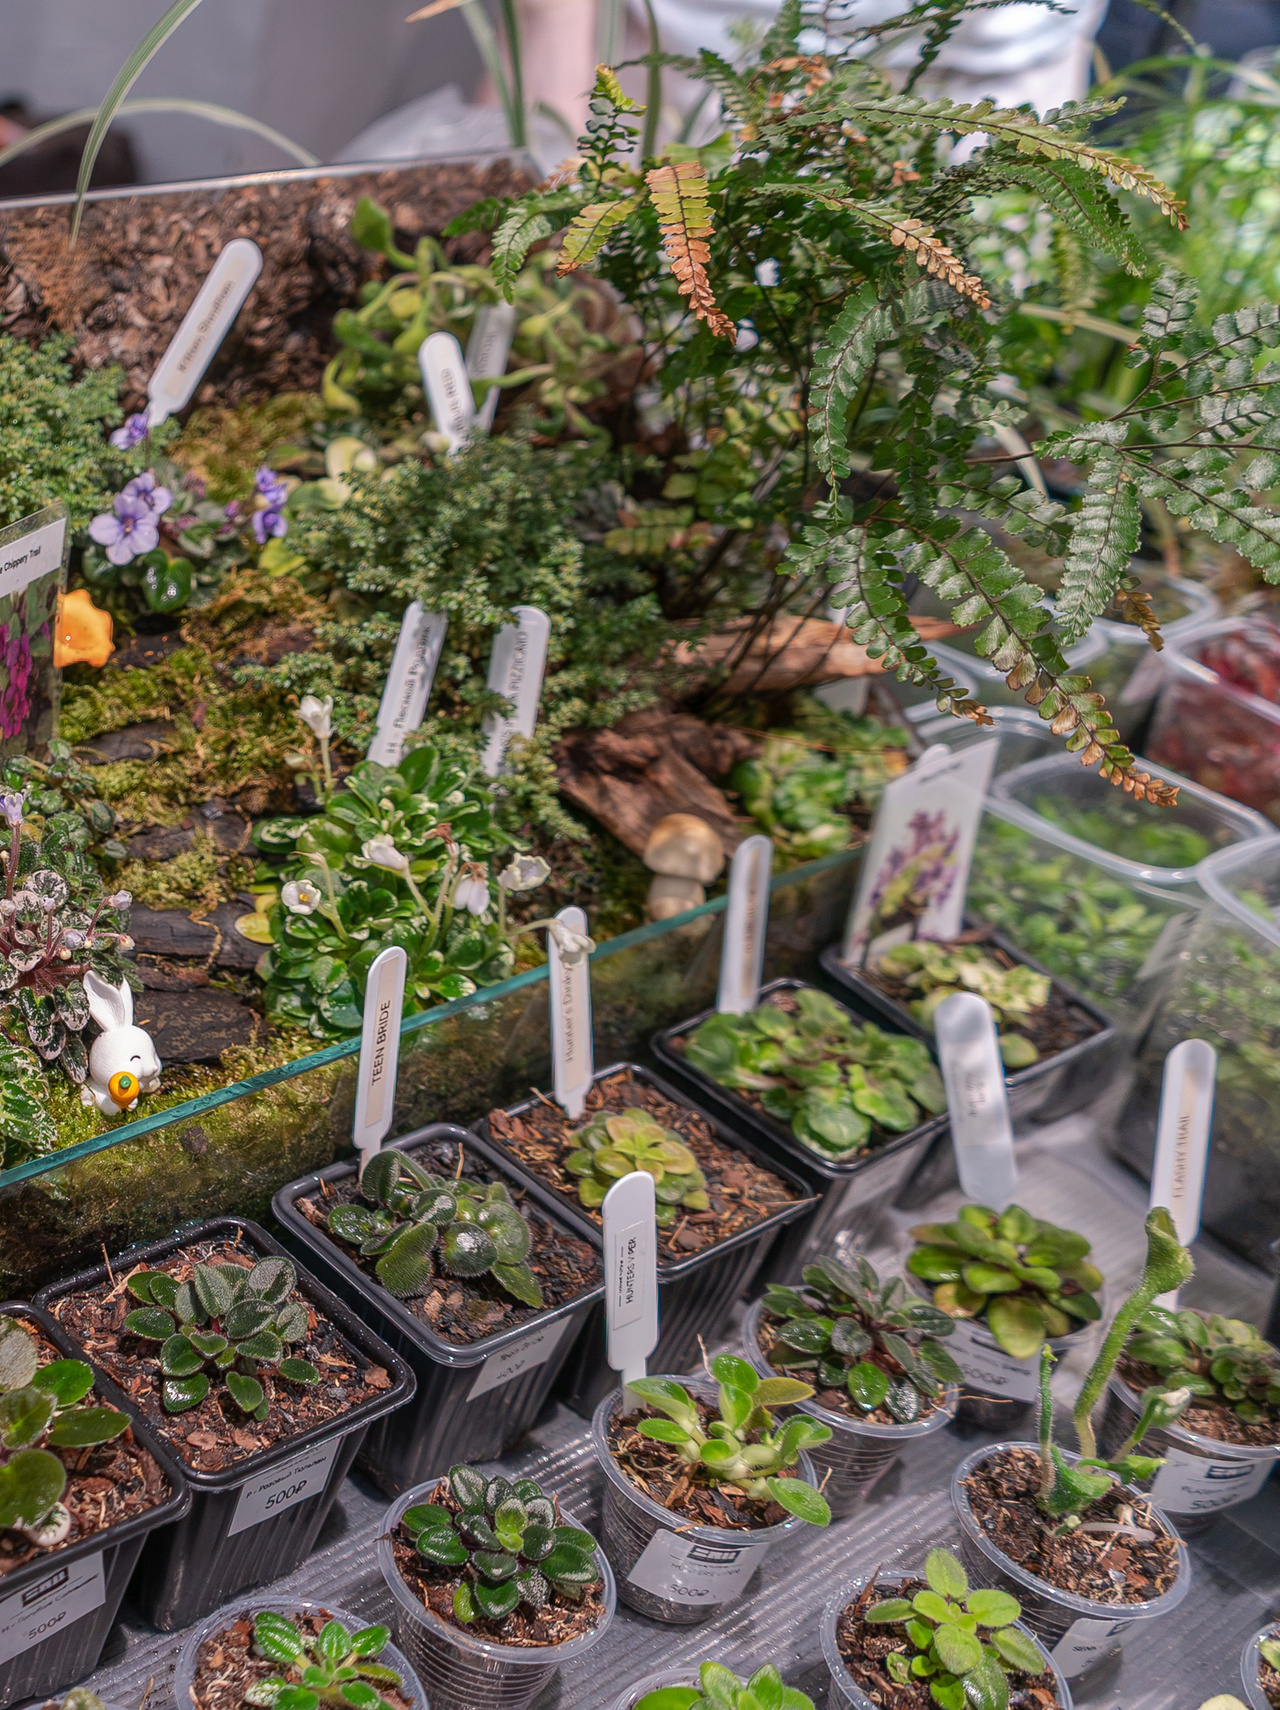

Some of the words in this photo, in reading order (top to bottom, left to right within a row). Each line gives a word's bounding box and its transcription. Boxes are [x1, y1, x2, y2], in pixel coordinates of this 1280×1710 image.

[4, 554, 28, 571] Chippery
[29, 545, 42, 558] Trail
[377, 1000, 391, 1045] BRIDE
[371, 1047, 385, 1086] TEEN
[627, 1236, 637, 1262] VPER
[625, 1263, 635, 1304] HUNTERS
[264, 1479, 308, 1510] 500₽
